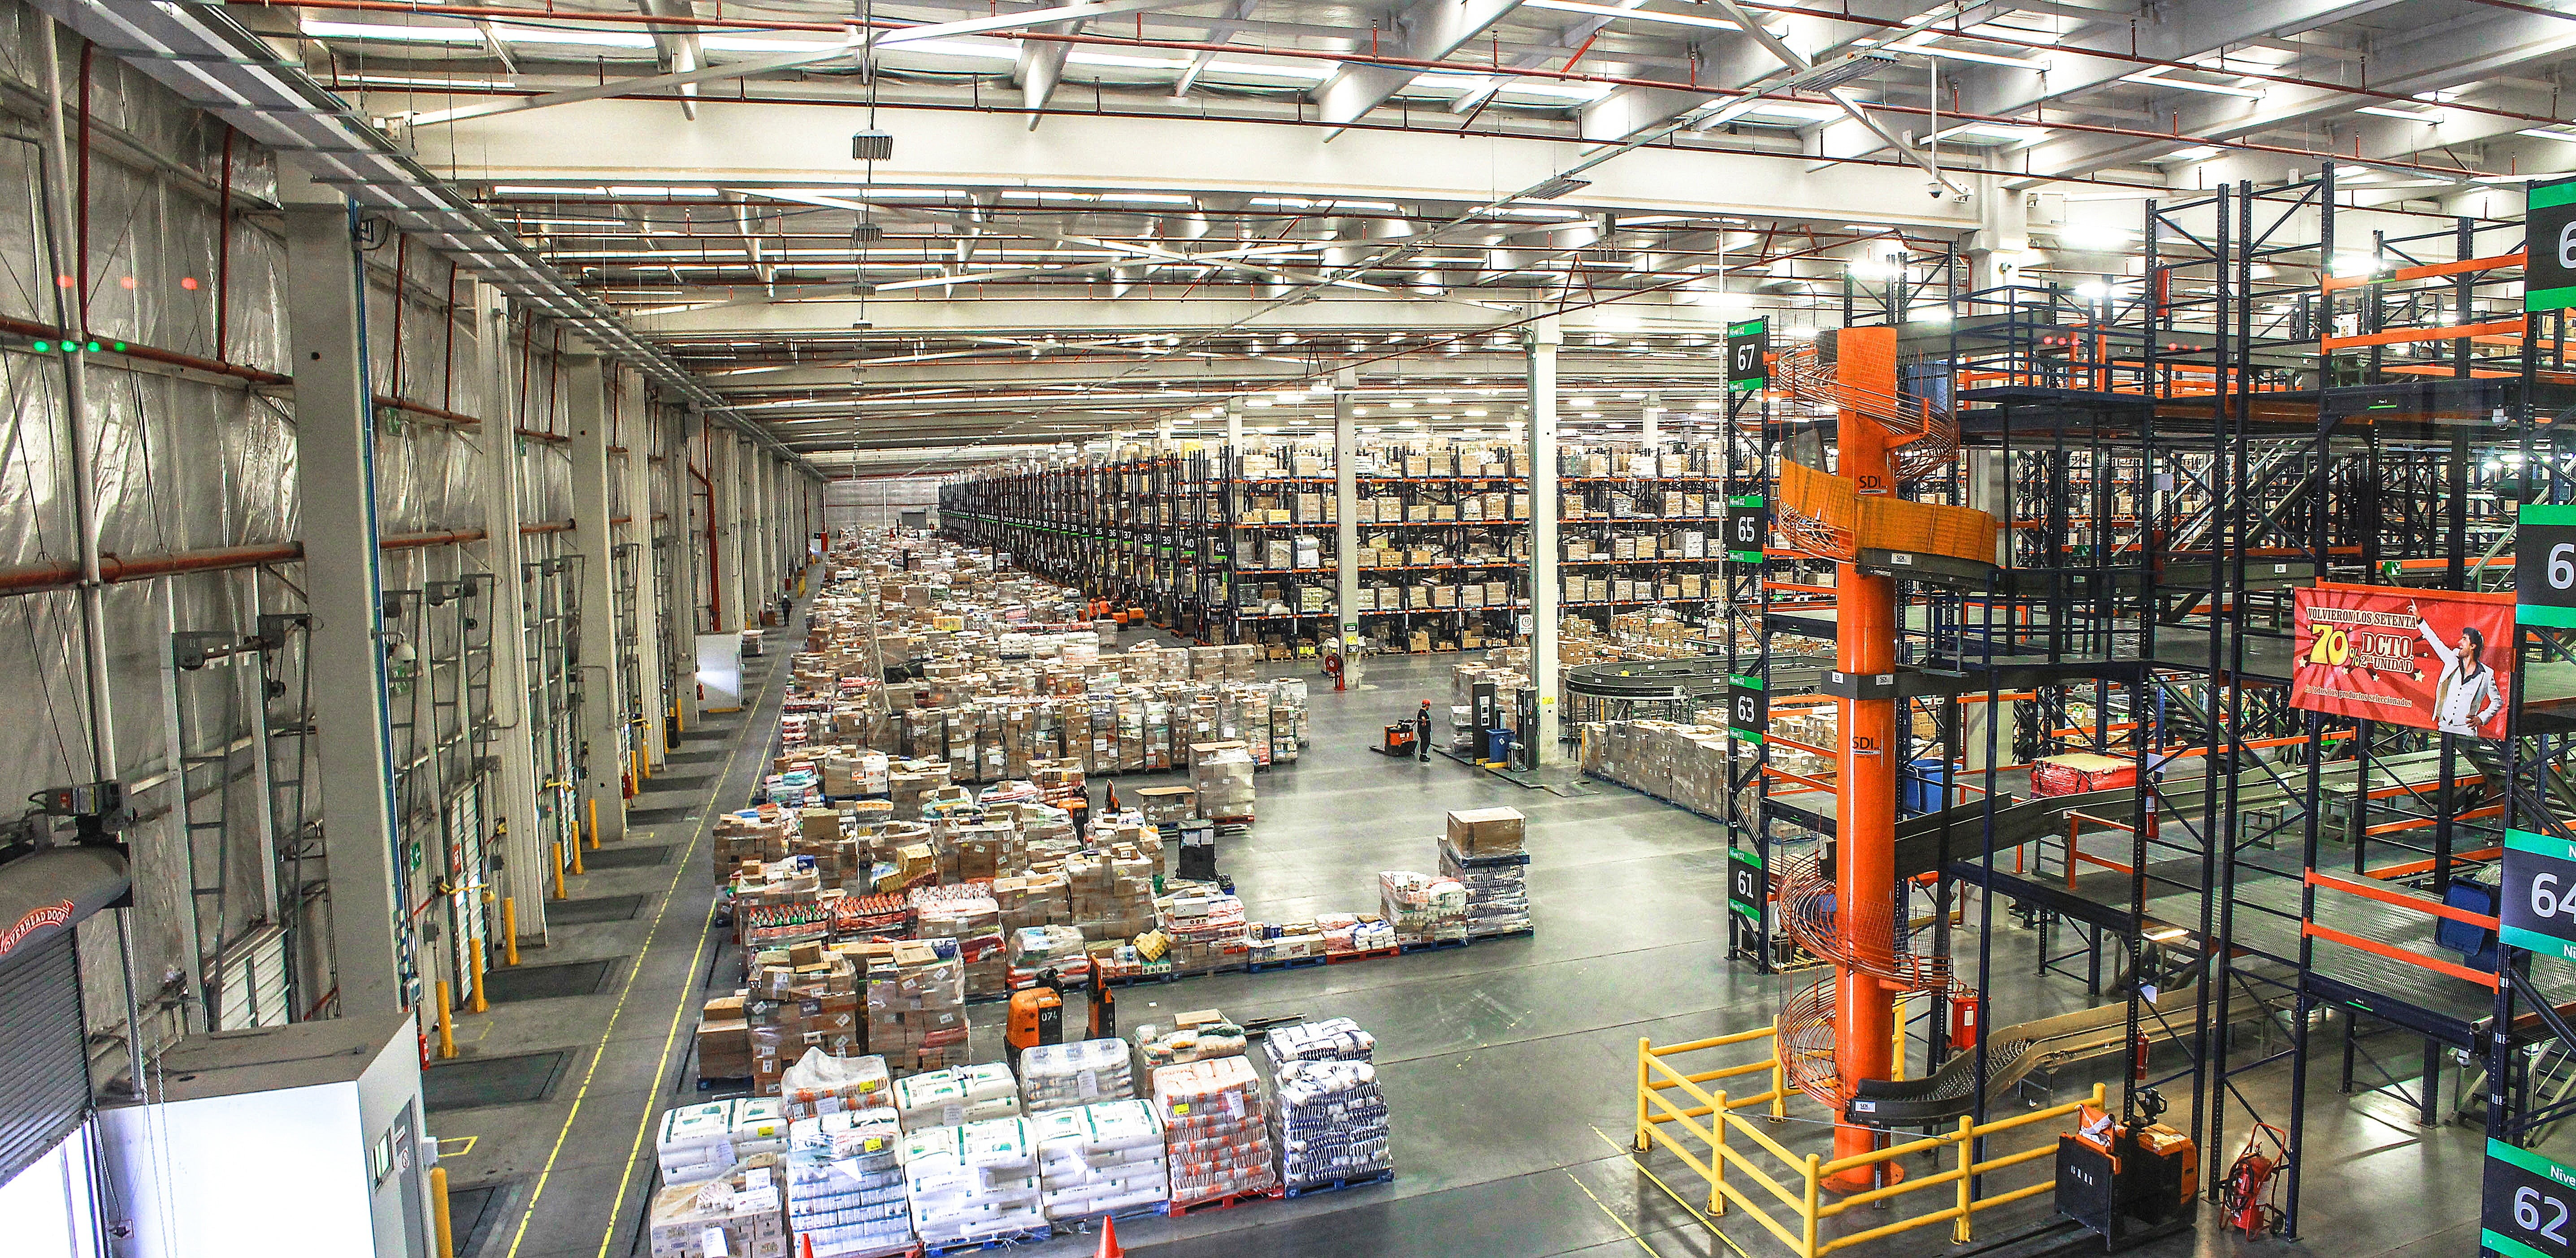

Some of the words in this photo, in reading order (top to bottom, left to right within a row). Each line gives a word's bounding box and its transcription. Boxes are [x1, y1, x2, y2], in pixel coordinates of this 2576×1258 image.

[1729, 328, 1739, 336] Nivel
[1739, 327, 1745, 335] 02
[1738, 344, 1755, 371] 67
[1859, 476, 1881, 488] SDI
[1738, 516, 1755, 542] 65
[1162, 536, 1171, 544] 39
[1185, 539, 1194, 548] 40
[1215, 542, 1225, 552] 41
[2308, 608, 2354, 622] VOLVIERON
[2356, 612, 2372, 623] LOS
[2374, 614, 2416, 627] SETENTA
[2361, 632, 2414, 660] DCTO.
[2373, 658, 2413, 672] UNIDAD
[1730, 676, 1739, 684] Nivel
[2312, 686, 2327, 695] todos
[2339, 690, 2368, 700] productos
[2368, 694, 2412, 707] seleccionados
[1738, 696, 1755, 722] 63
[1730, 730, 1739, 738] Nivel
[1852, 736, 1874, 749] SDI
[1729, 849, 1739, 858] Nivel
[1738, 870, 1753, 899] 61
[1730, 901, 1739, 910] Nivel
[2531, 873, 2576, 924] 64
[4, 912, 46, 951] OVERHEAD
[2550, 1164, 2576, 1187] Nive
[2514, 1186, 2568, 1246] 62
